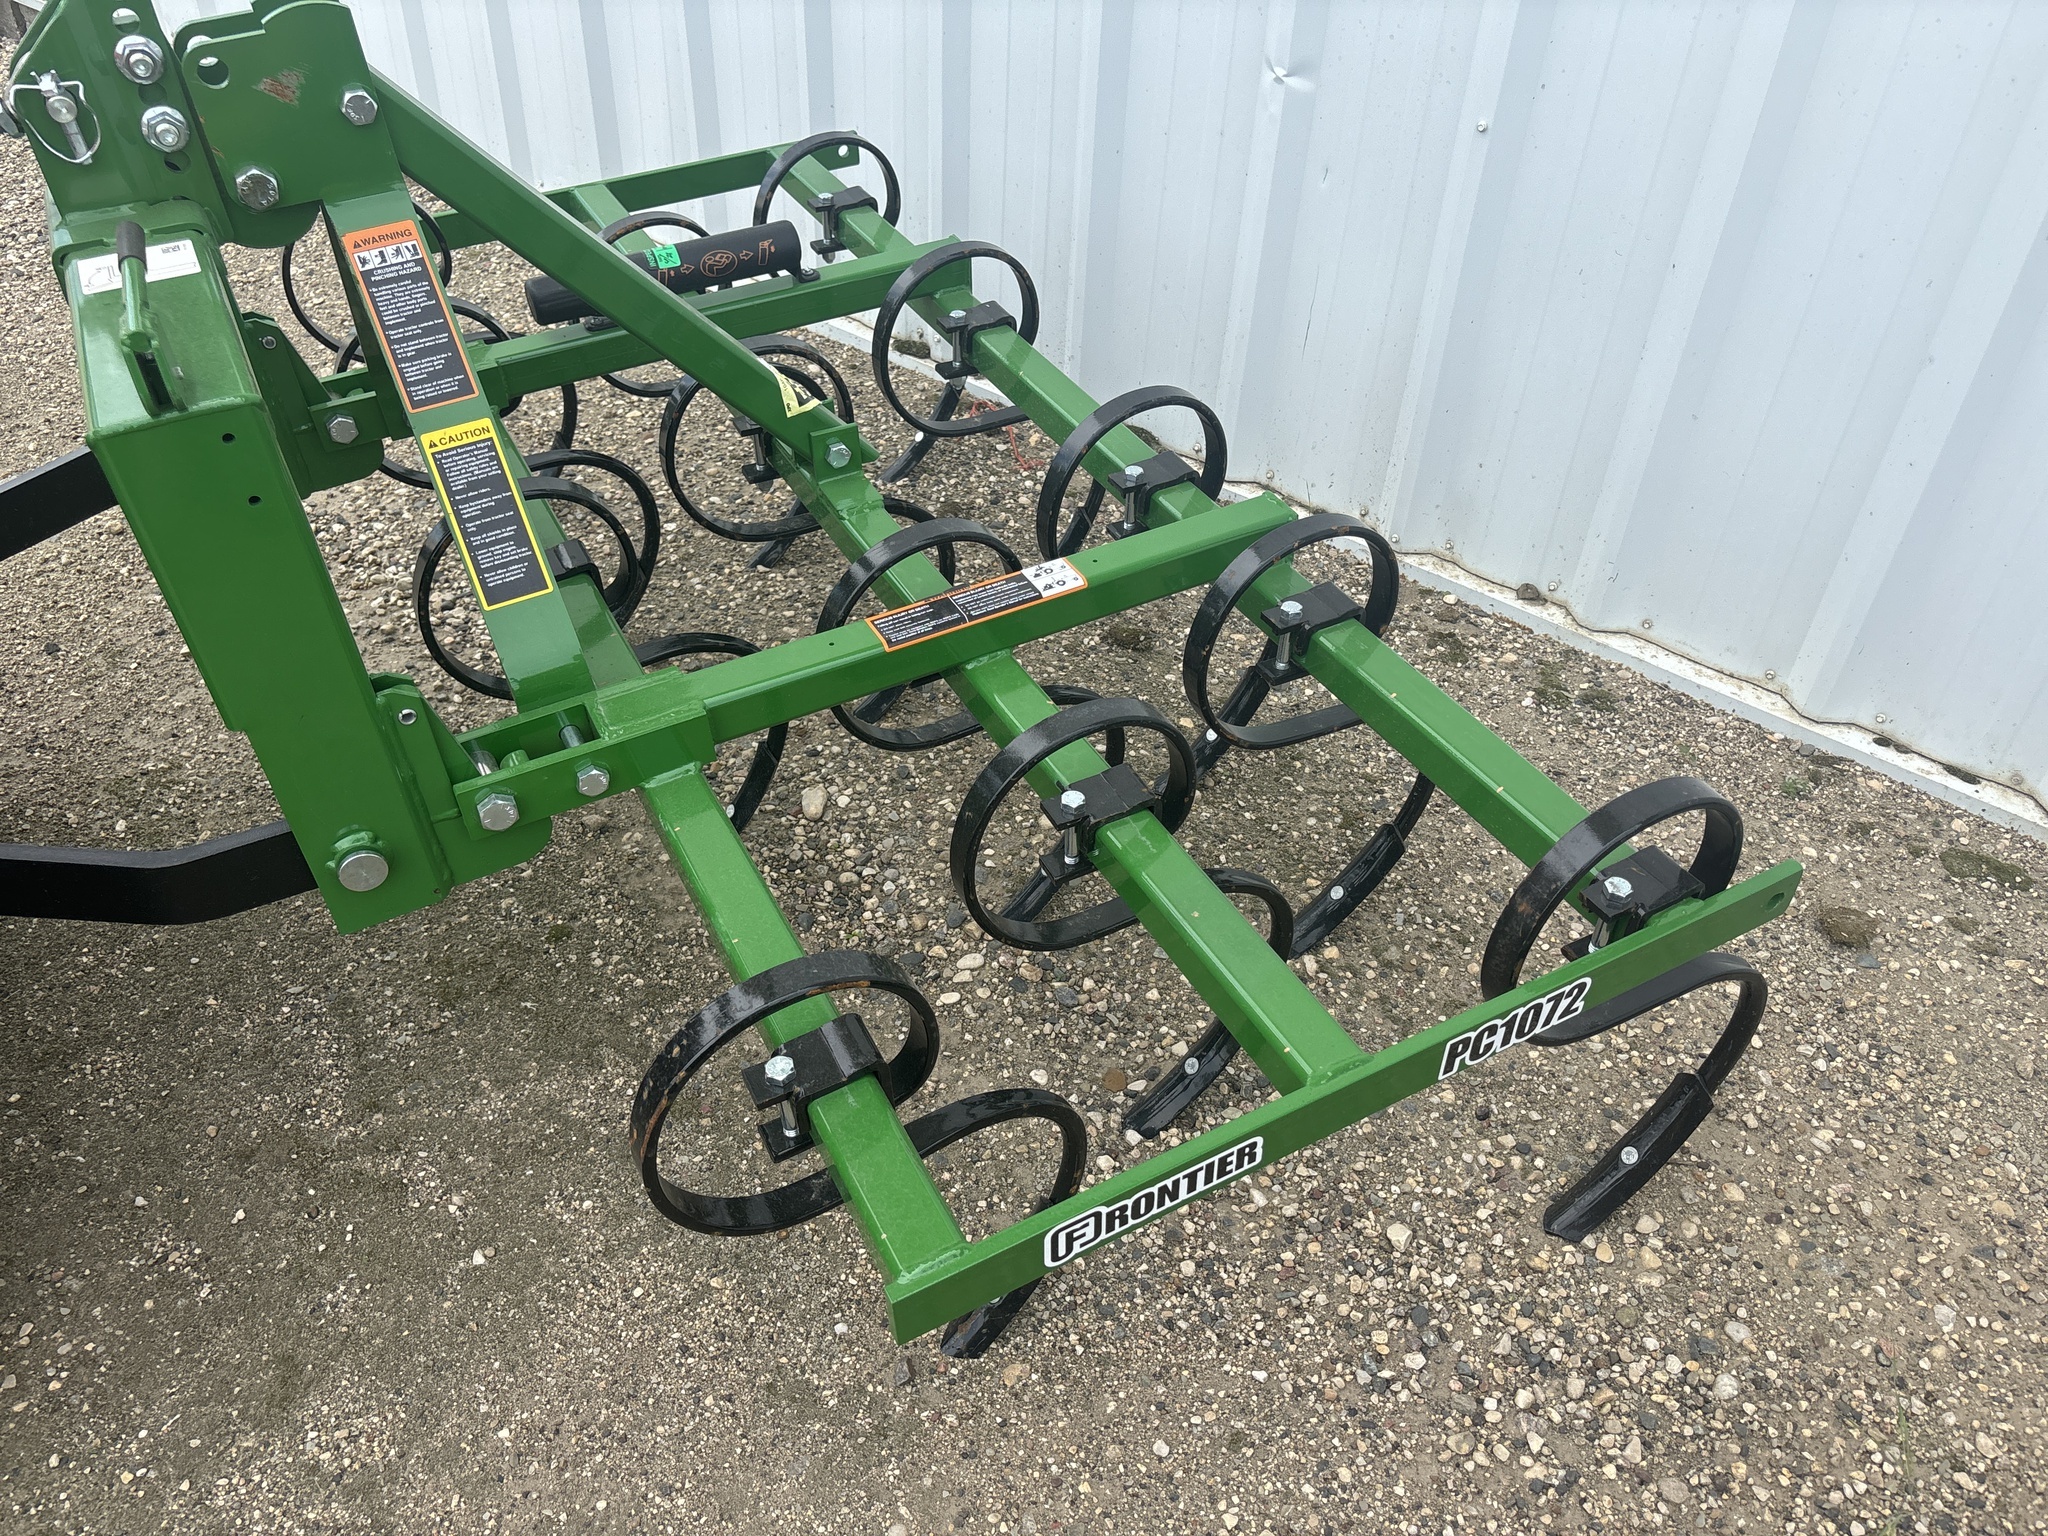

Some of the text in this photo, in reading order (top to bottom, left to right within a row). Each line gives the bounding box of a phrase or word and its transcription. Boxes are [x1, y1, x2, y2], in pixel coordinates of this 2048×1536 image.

[361, 228, 412, 247] WARNING
[371, 266, 422, 281] PINCHING HAZARD
[373, 265, 403, 275] CRUSHING
[439, 426, 491, 446] CAUTION
[457, 445, 476, 453] Serious
[1441, 981, 1588, 1077] PC1072
